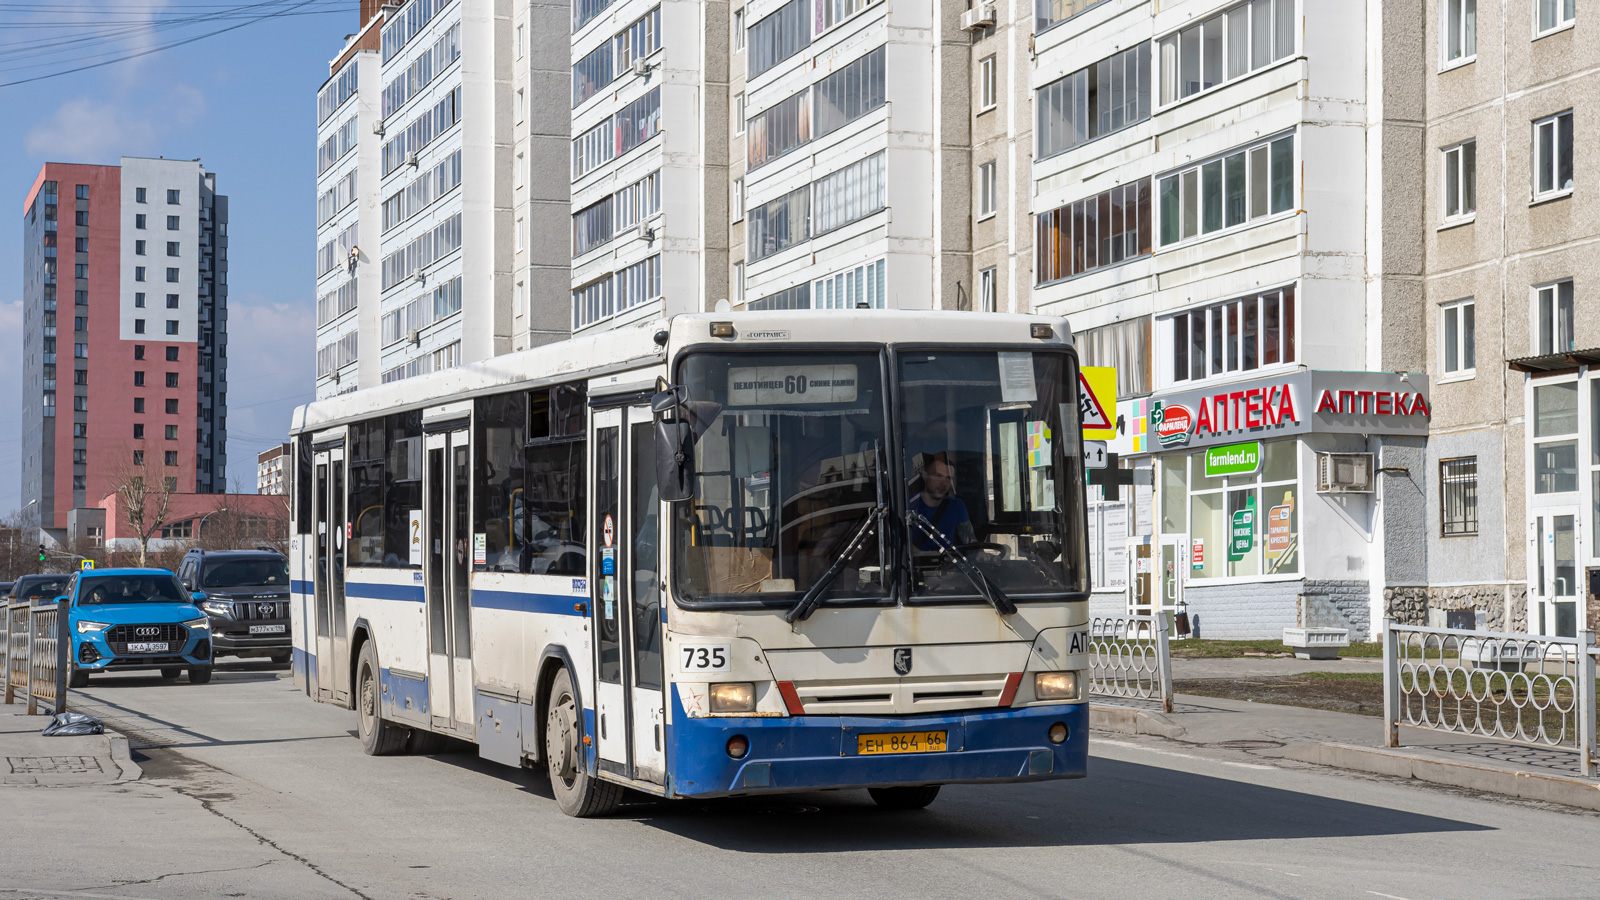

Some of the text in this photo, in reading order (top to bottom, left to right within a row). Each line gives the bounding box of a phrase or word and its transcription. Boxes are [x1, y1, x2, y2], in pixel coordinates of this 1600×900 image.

[733, 380, 783, 390] ПЕХОТИНЦЕВ
[784, 374, 807, 395] 60
[809, 379, 831, 388] СИНИЕ
[1195, 383, 1300, 435] АПТЕКА
[1315, 389, 1429, 416] АПТЕКА
[1159, 420, 1188, 432] ФАРМЛЕНД
[1209, 450, 1256, 468] farmlend.ru
[1233, 527, 1251, 537] НИЗКИЕ
[1235, 539, 1249, 550] ЦЕНЫ
[683, 647, 726, 669] 735
[890, 735, 919, 750] 864
[927, 733, 941, 745] 66
